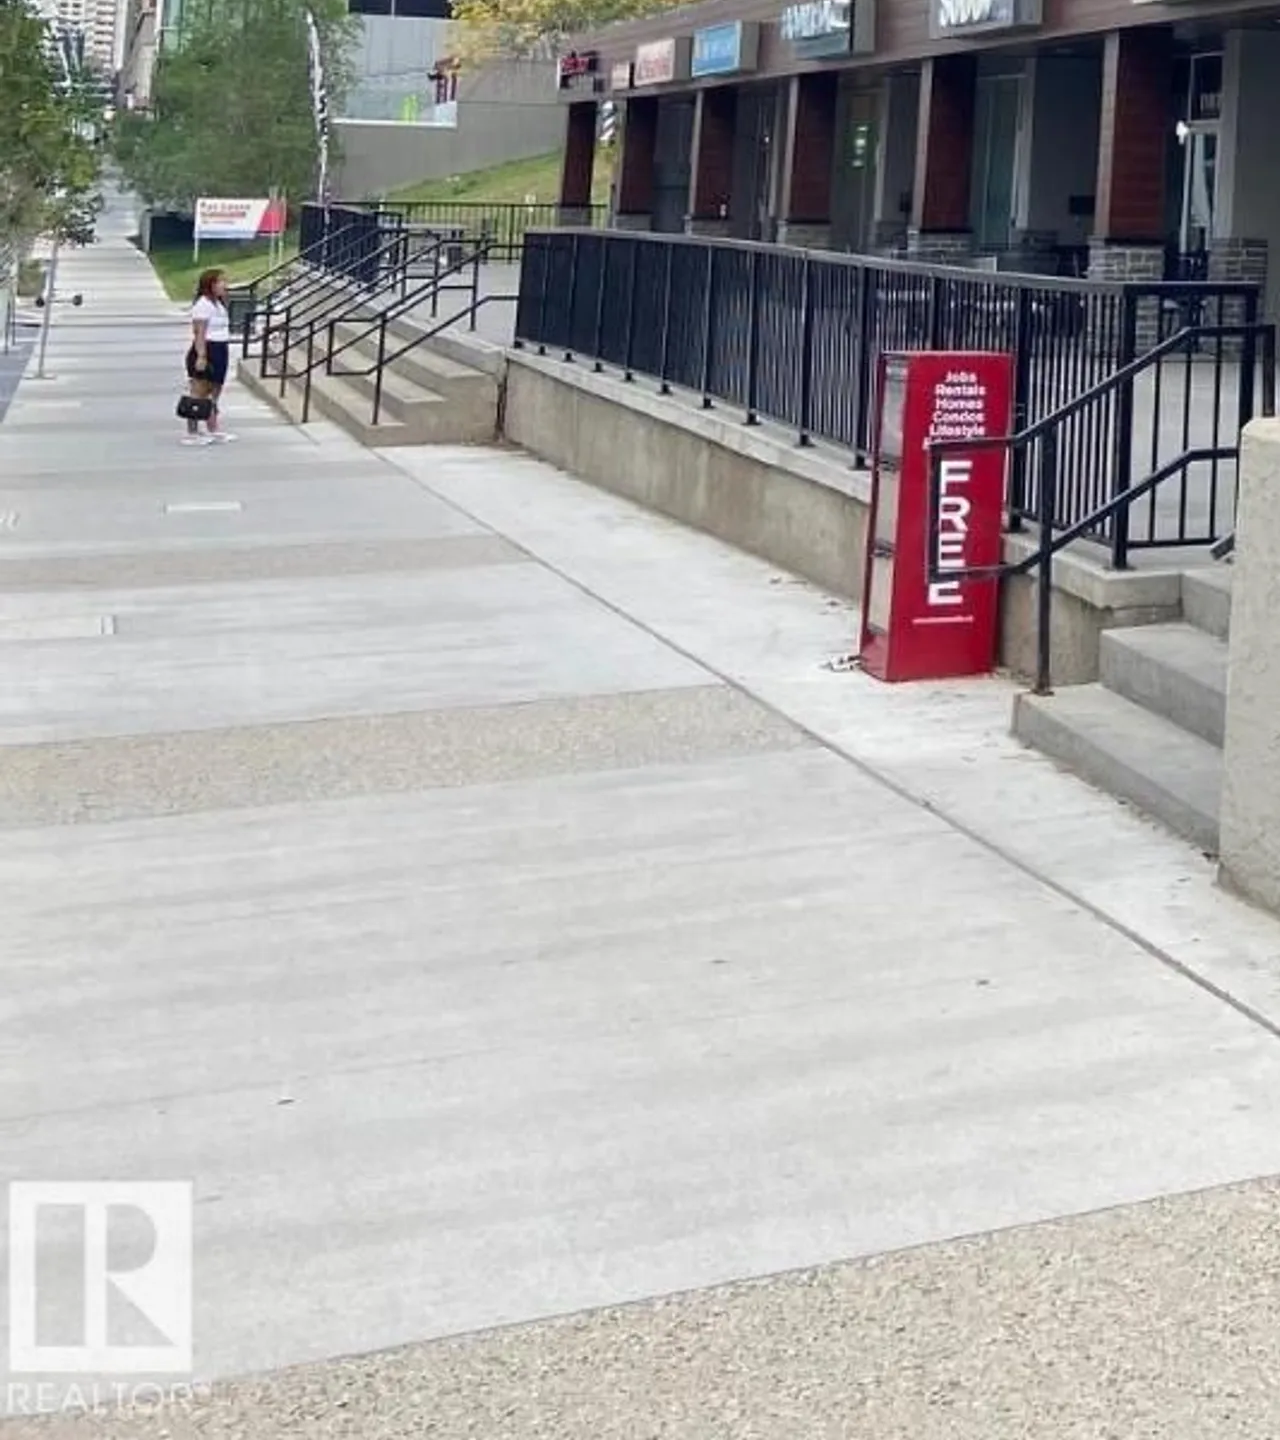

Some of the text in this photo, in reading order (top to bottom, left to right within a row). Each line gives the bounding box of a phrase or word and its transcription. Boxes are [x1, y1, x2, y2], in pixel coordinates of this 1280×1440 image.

[945, 370, 977, 383] Jobs
[934, 384, 986, 396] Rentals
[935, 397, 984, 410] Homes
[932, 411, 985, 423] Condos
[928, 423, 986, 439] Lifestyle
[927, 460, 973, 604] FREE
